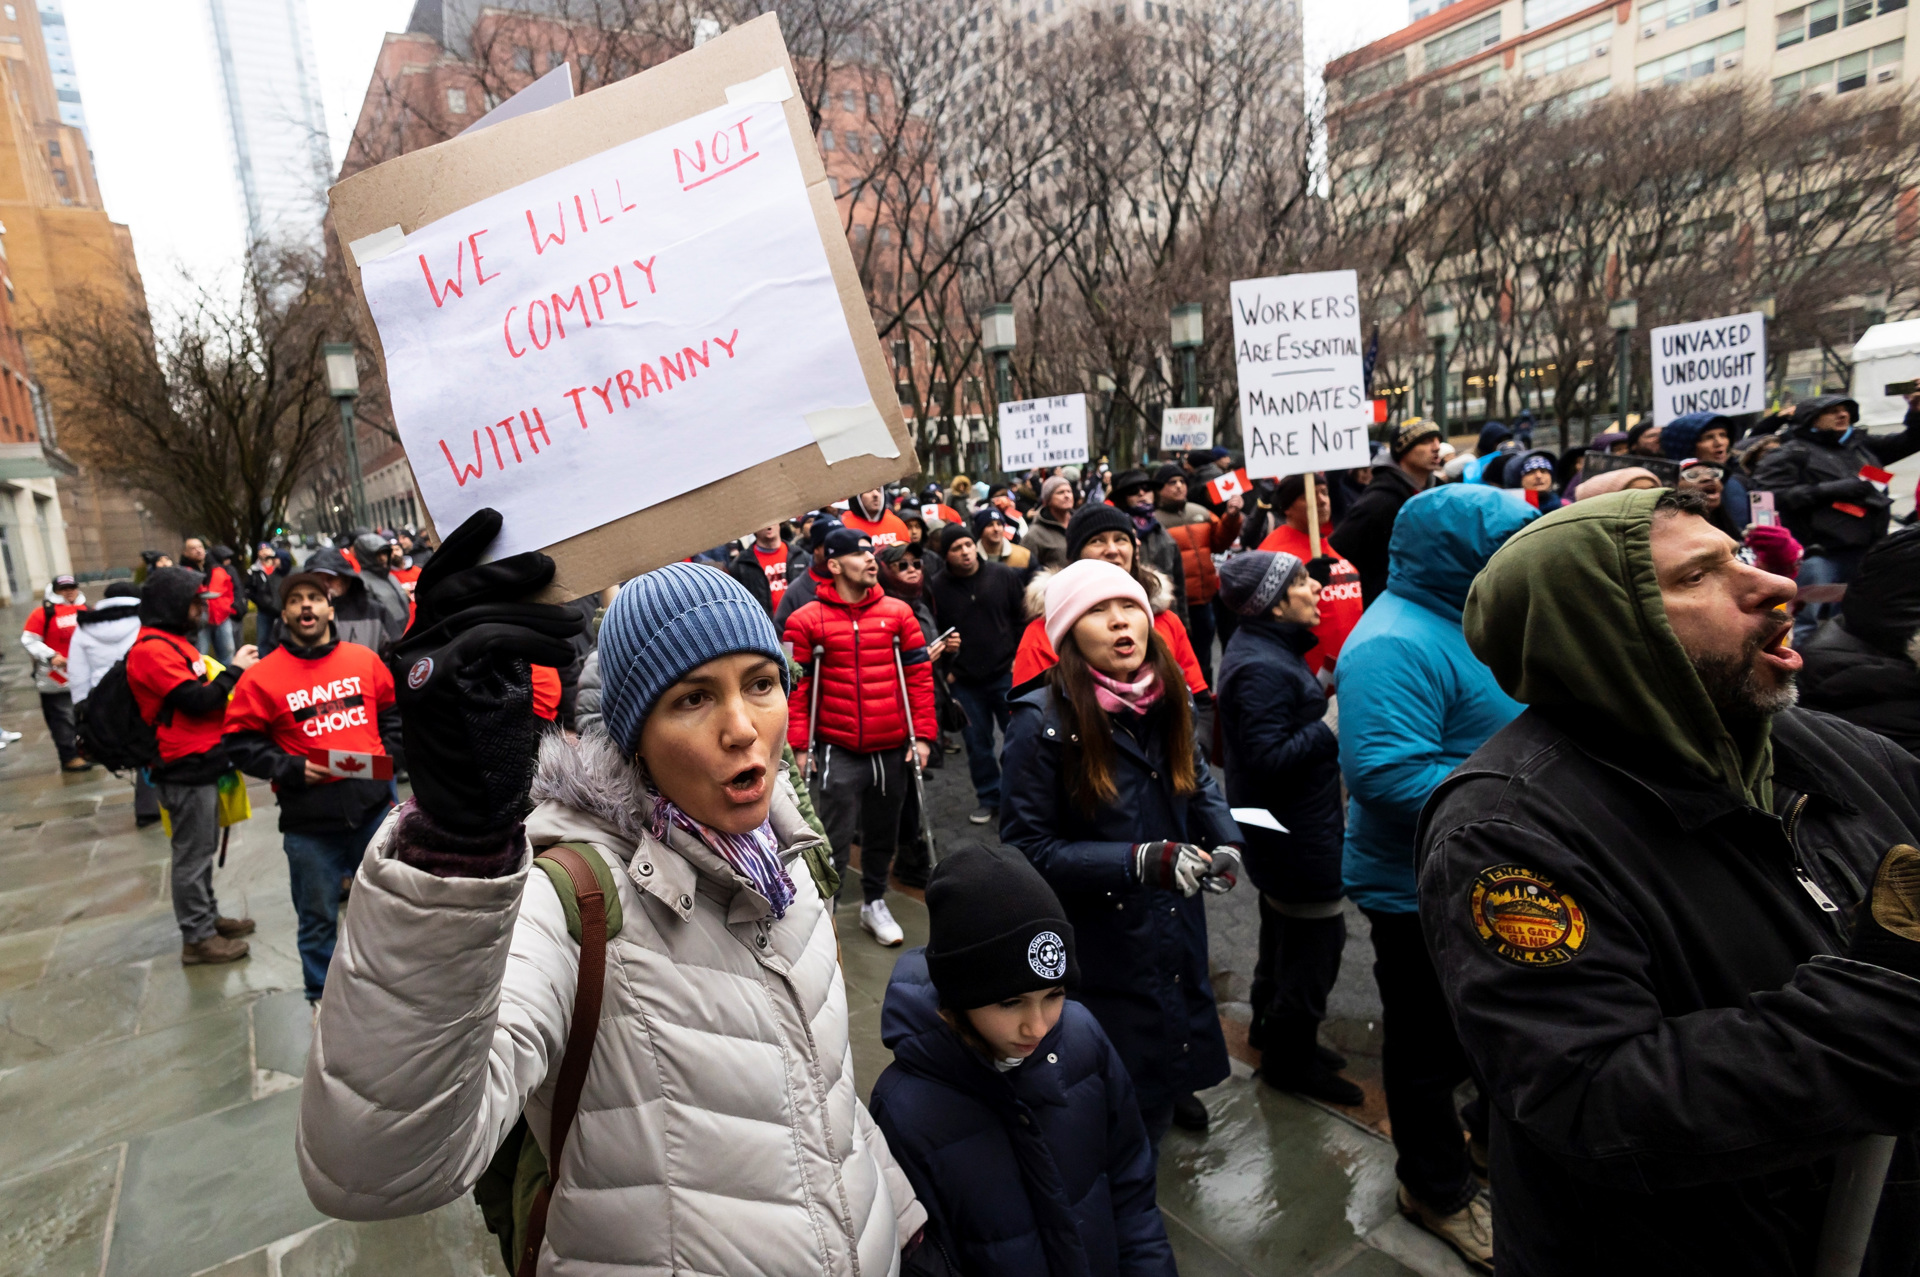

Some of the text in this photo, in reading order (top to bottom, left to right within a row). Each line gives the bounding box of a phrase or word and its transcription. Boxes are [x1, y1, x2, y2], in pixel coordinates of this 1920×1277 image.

[418, 115, 754, 308] WE WILL NOT
[503, 255, 657, 358] COMPLY
[1238, 294, 1356, 326] WORKERS
[1237, 333, 1361, 364] ARE ESSENTIAL
[1662, 324, 1751, 357] UNVAXED
[1662, 352, 1756, 386] UNBOUGHT
[439, 328, 739, 487] WITH TYRANNY
[1006, 396, 1069, 414] WHOM THE
[1249, 385, 1362, 416] MANDATES
[1672, 383, 1751, 416] UNSOLD!
[1016, 423, 1072, 439] SET FREE
[1029, 413, 1050, 424] SON
[1037, 439, 1050, 449] IS
[1251, 421, 1362, 458] ARE NOT
[1007, 448, 1085, 465] FREE INDEED
[286, 676, 362, 712] BRAVEST
[316, 699, 346, 716] FOR
[302, 706, 369, 737] CHOICE
[1498, 924, 1558, 940] HELL GATE
[1508, 934, 1549, 947] GANG
[1030, 959, 1055, 977] SOCCER
